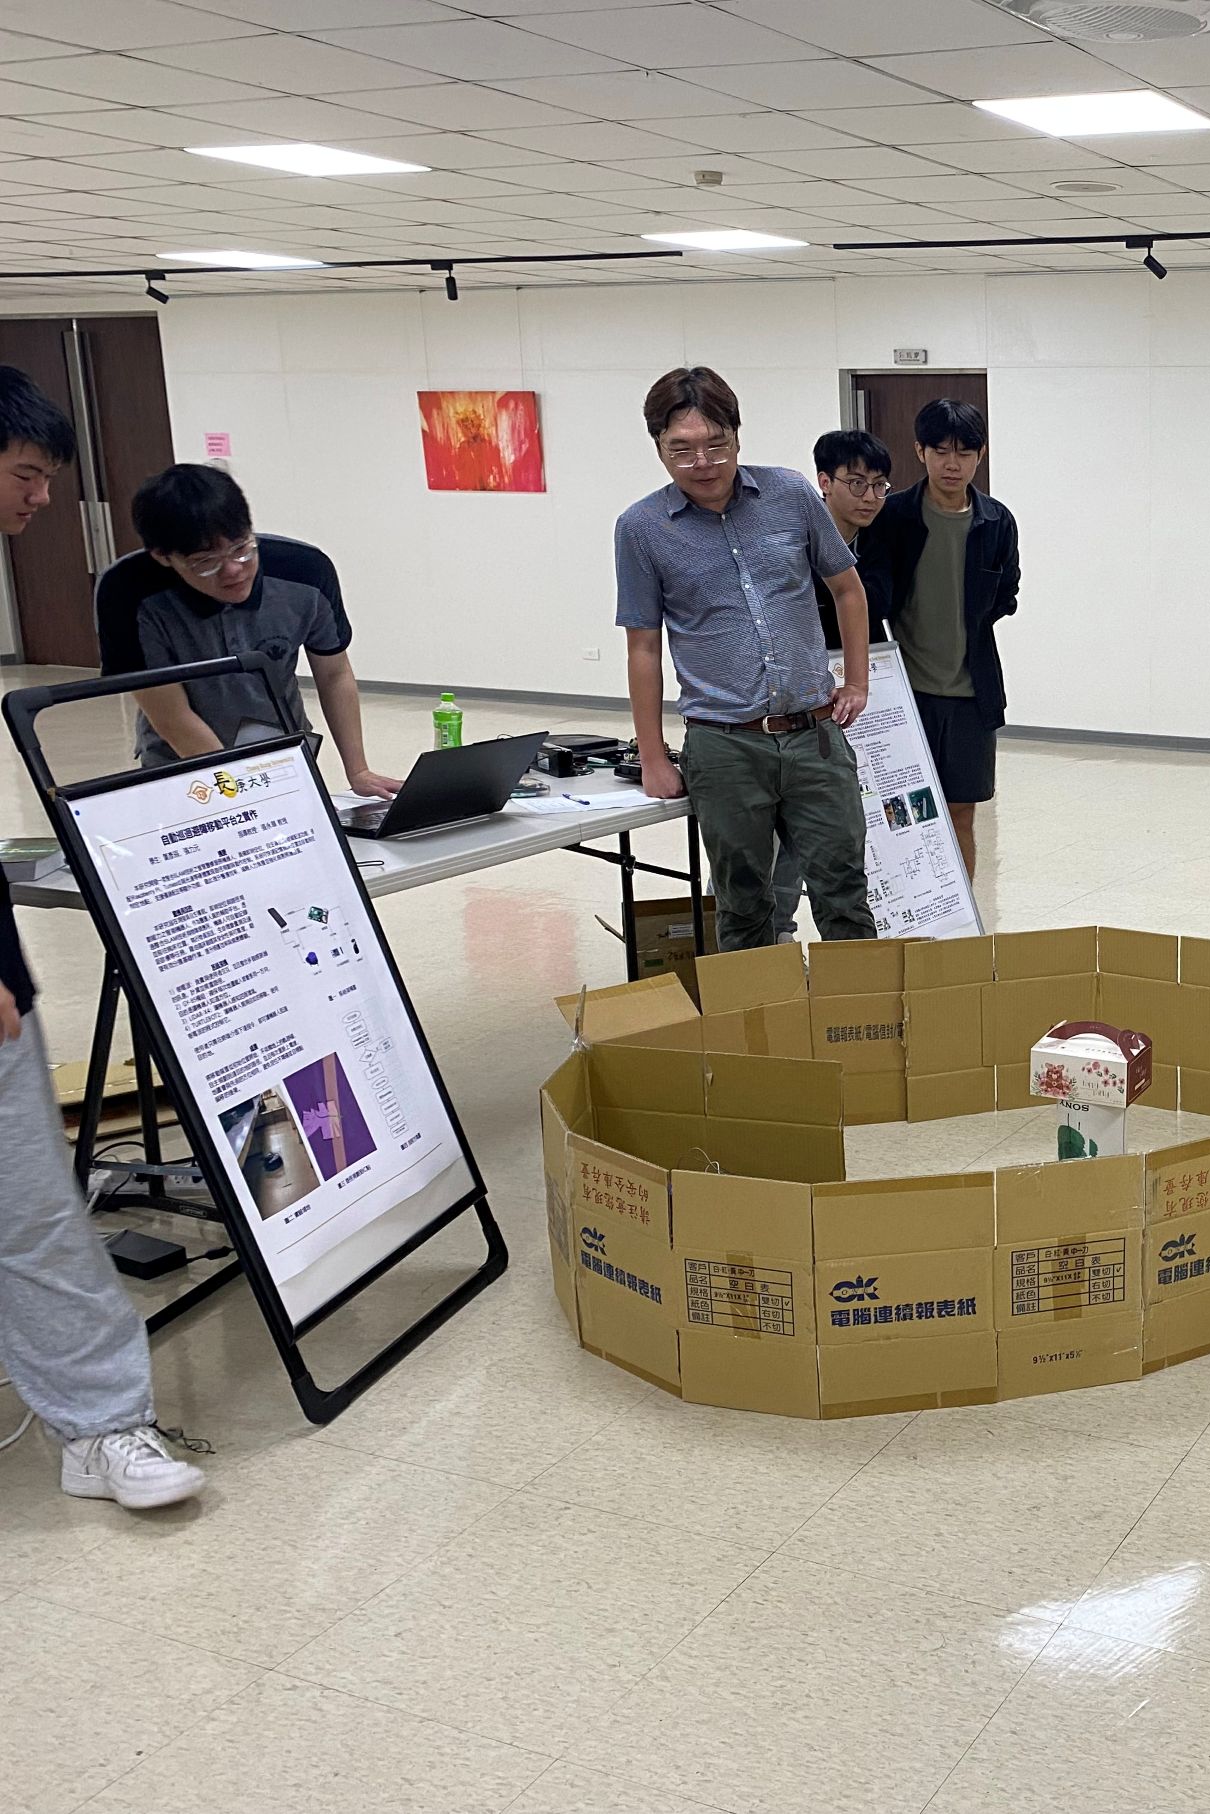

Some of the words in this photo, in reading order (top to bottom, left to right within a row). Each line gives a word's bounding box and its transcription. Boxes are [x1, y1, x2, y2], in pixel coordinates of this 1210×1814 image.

[214, 771, 271, 794] 長庚大學
[1060, 1099, 1090, 1111] SONY
[1159, 1233, 1197, 1262] OK
[1015, 1252, 1036, 1262] 客戶
[688, 1262, 707, 1271] 客戶
[1016, 1264, 1036, 1275] 品名
[1092, 1267, 1111, 1277] 雙切
[580, 1250, 662, 1305] 電腦連續報表紙
[689, 1275, 708, 1285] 品名
[1016, 1277, 1036, 1288] 規格
[829, 1275, 881, 1303] OK
[1092, 1279, 1110, 1290] 右切
[690, 1287, 709, 1297] 規格
[1016, 1290, 1036, 1300] 紙色
[1092, 1292, 1110, 1302] 不切
[691, 1300, 709, 1310] 紙色
[761, 1296, 780, 1306] 雙切
[762, 1309, 780, 1319] 右切
[830, 1297, 976, 1327] 電腦連續報表紙
[763, 1322, 780, 1331] 不切
